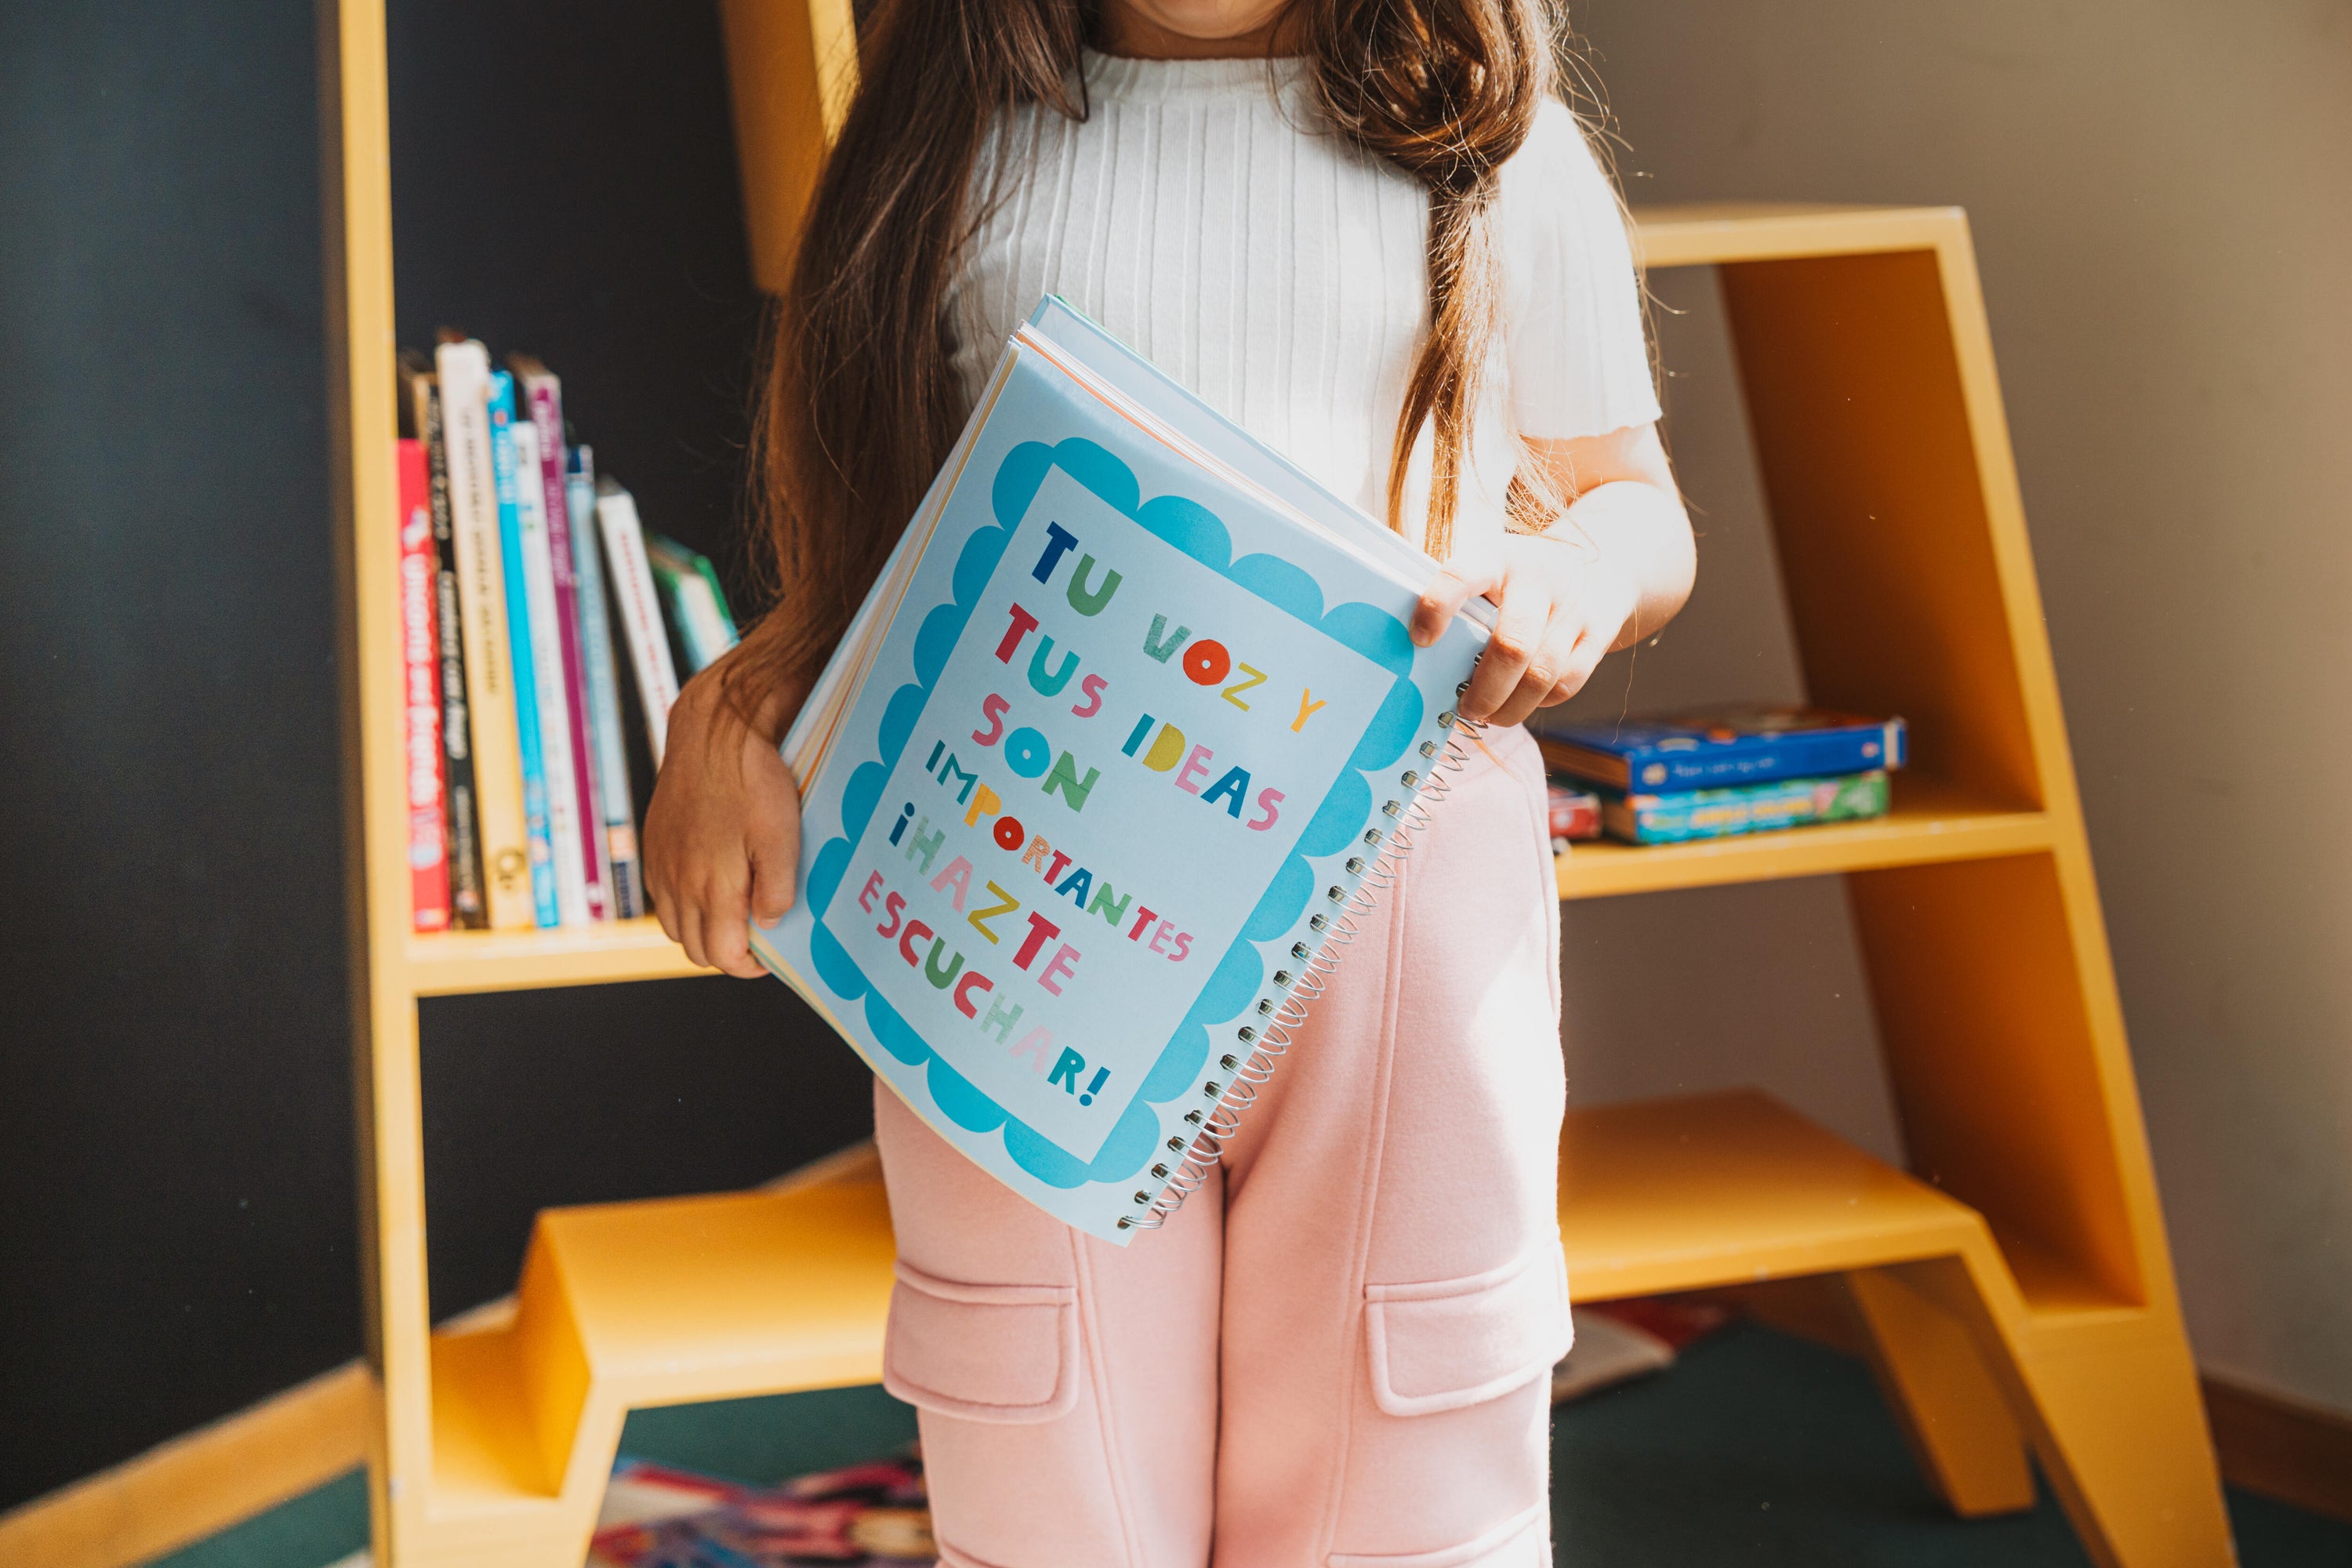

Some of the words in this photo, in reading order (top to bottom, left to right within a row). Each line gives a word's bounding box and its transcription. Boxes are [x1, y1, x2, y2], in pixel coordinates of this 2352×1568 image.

[993, 601, 1109, 719] TUS
[1121, 713, 1287, 832] IDEAS
[1031, 520, 1123, 618] TU
[1143, 612, 1269, 713] VOZ
[1290, 687, 1328, 735] Y
[925, 739, 1195, 963] IMPORTANTES
[971, 692, 1102, 814] SON
[857, 869, 1117, 1115] ESCUCHAR!
[888, 801, 1082, 997] ¡HAZTE
